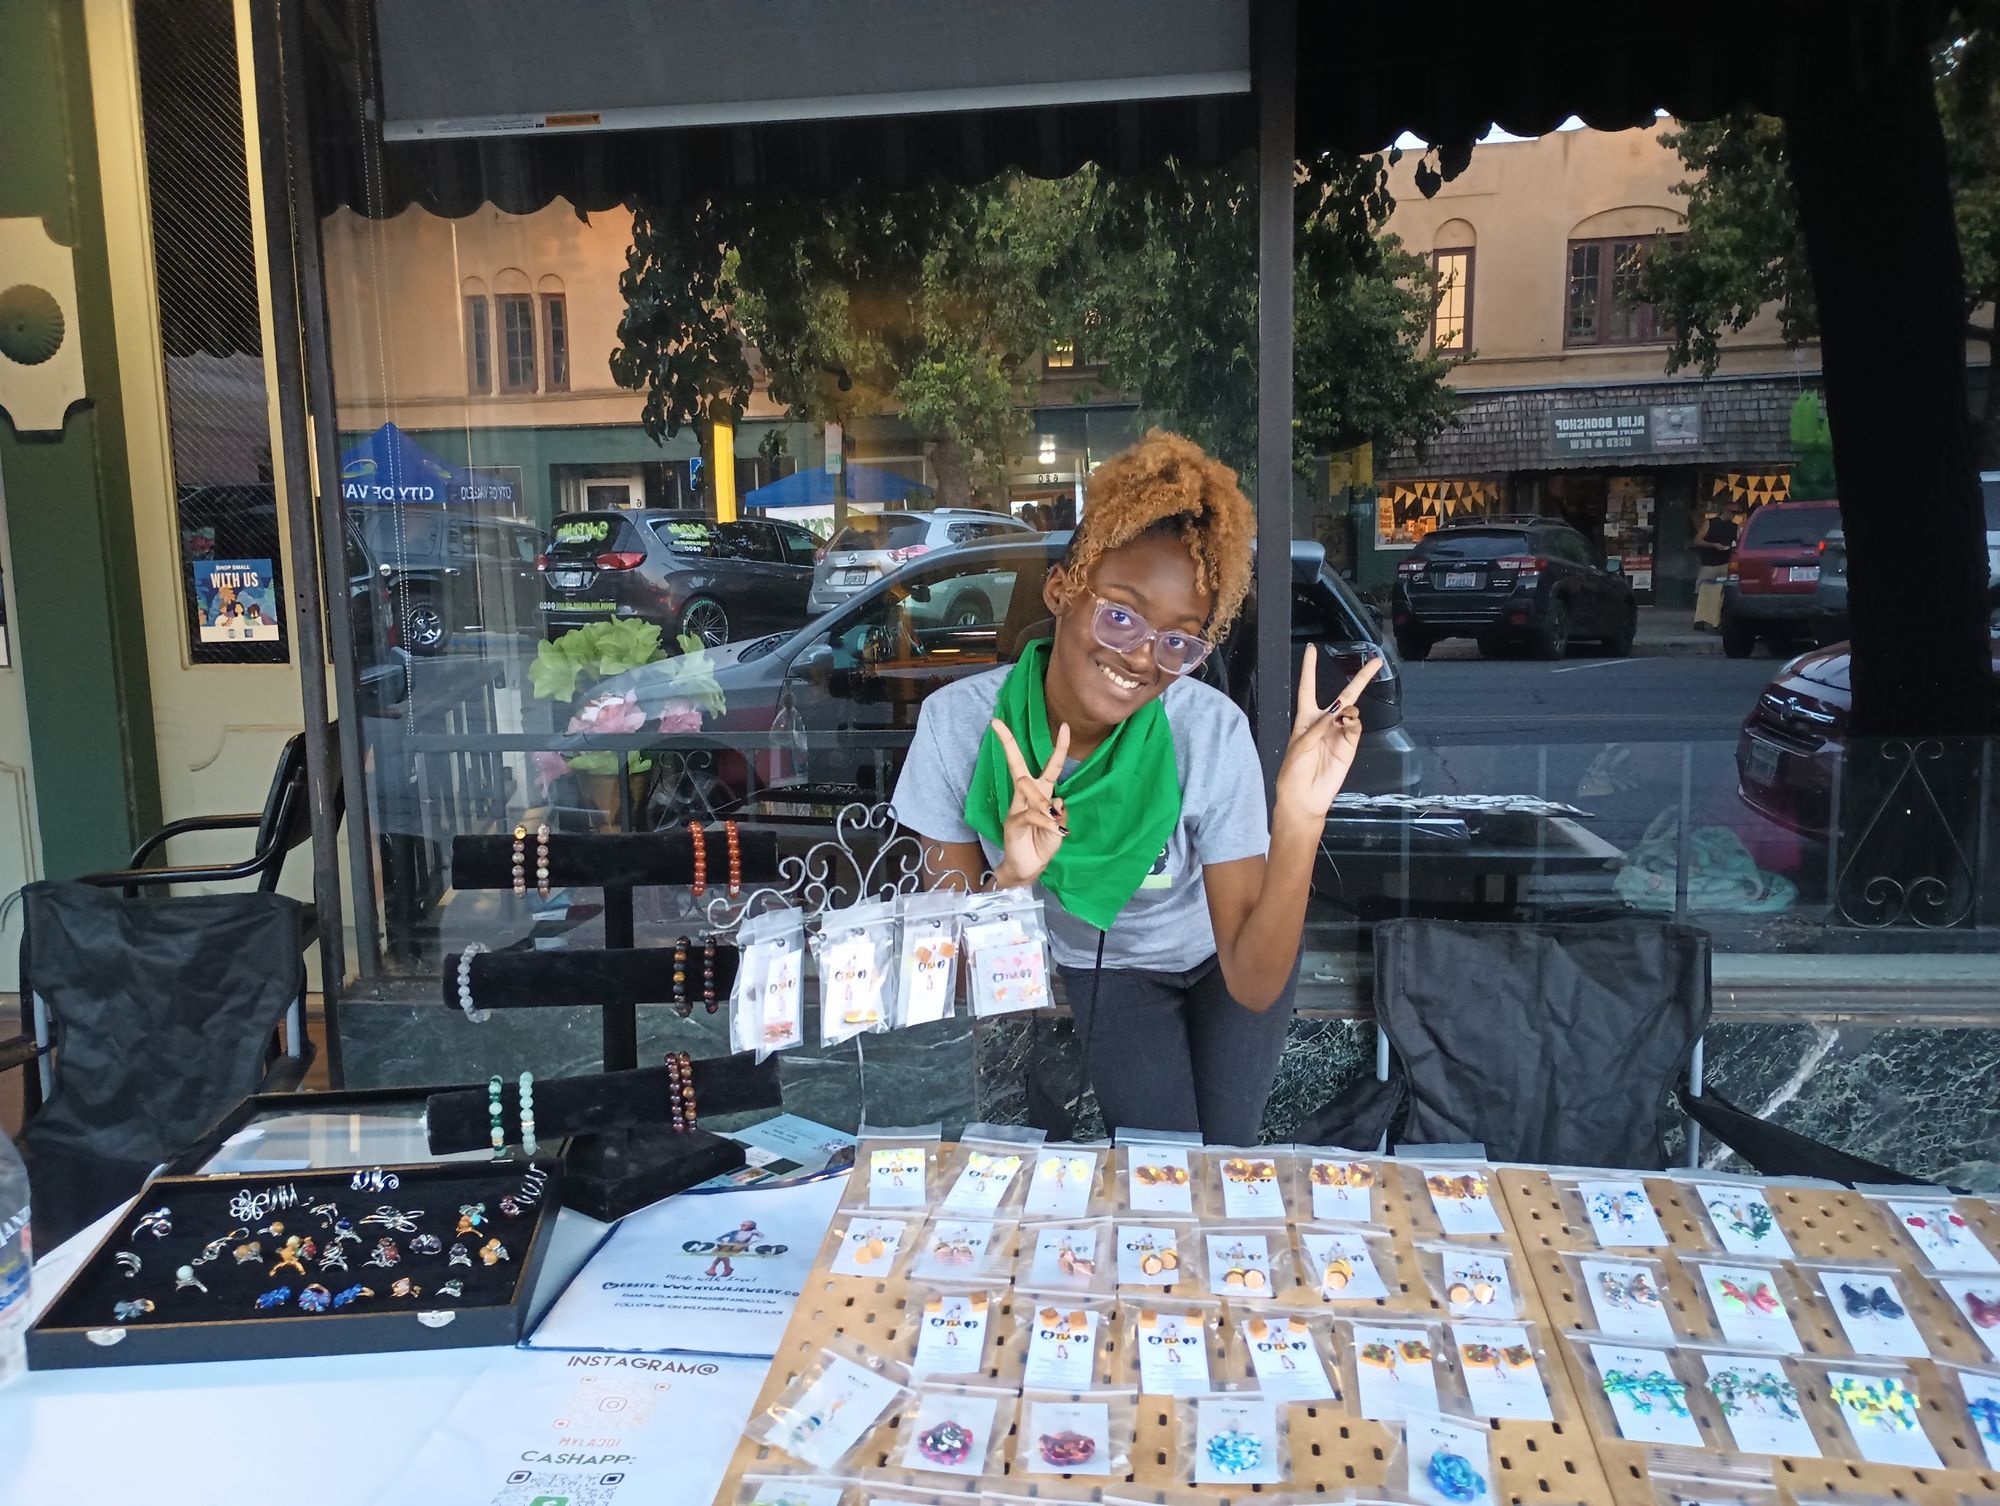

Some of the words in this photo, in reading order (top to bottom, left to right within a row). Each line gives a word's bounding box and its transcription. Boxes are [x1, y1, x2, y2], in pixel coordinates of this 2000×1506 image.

[210, 573, 240, 588] WITH
[244, 572, 259, 587] US
[567, 1355, 720, 1376] INSTAGRAM@
[521, 1450, 637, 1465] CASHAPP:
